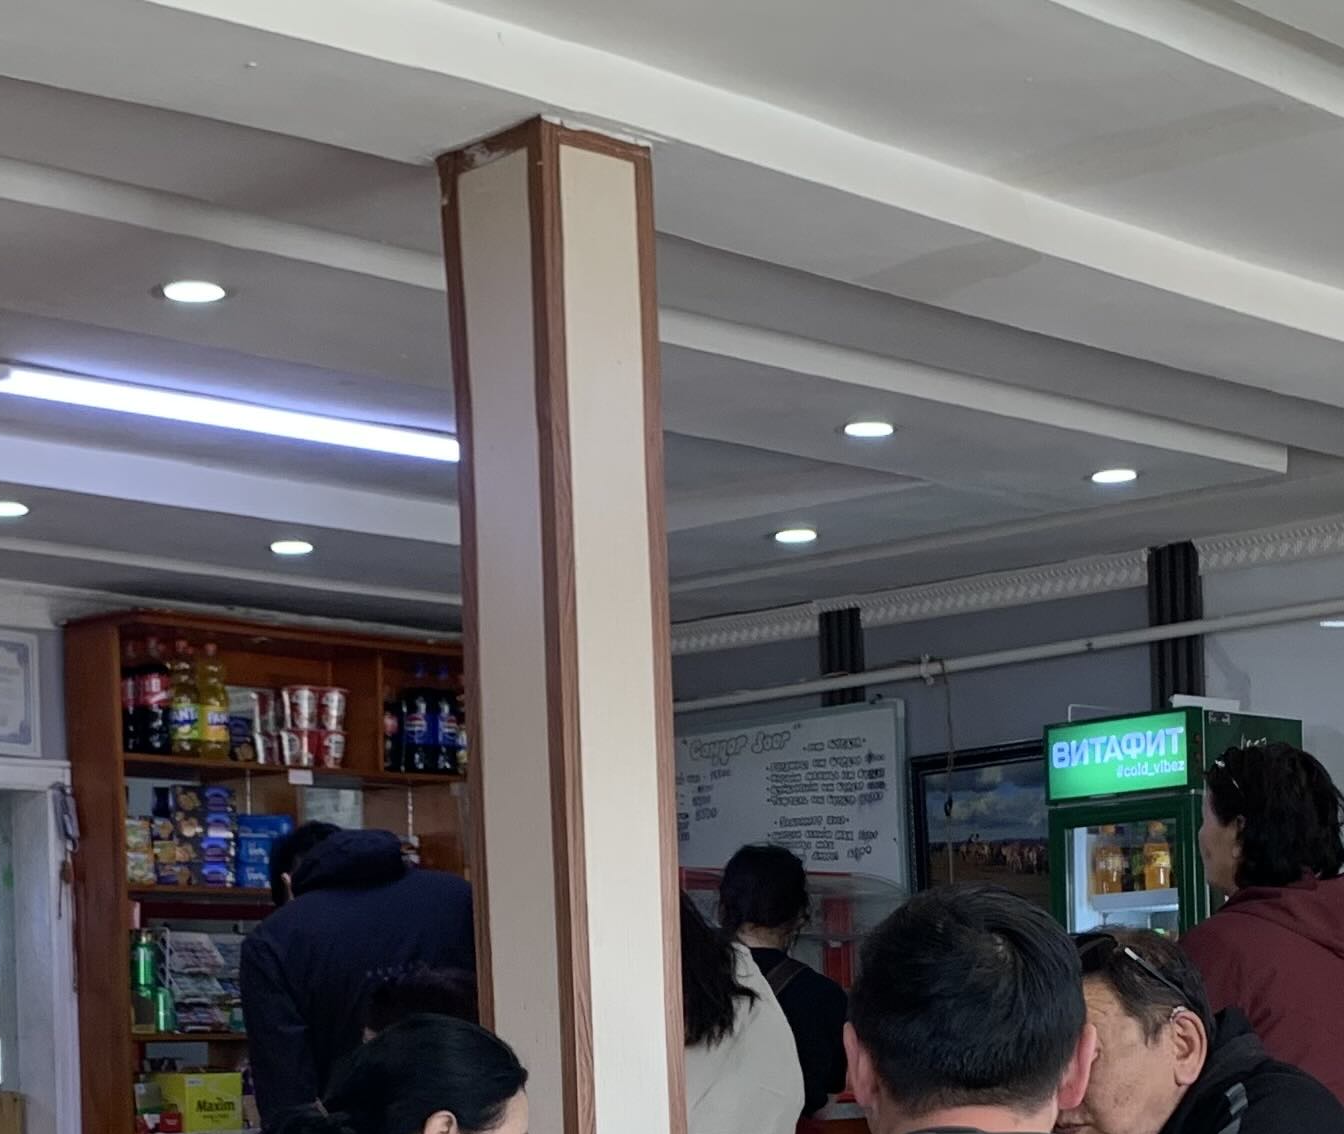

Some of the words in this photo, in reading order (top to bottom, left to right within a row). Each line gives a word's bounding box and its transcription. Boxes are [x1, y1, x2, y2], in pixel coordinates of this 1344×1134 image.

[1052, 726, 1184, 769] ВИТАФИТ
[1116, 760, 1185, 778] #cold_vibez
[196, 1097, 236, 1113] Maxim
